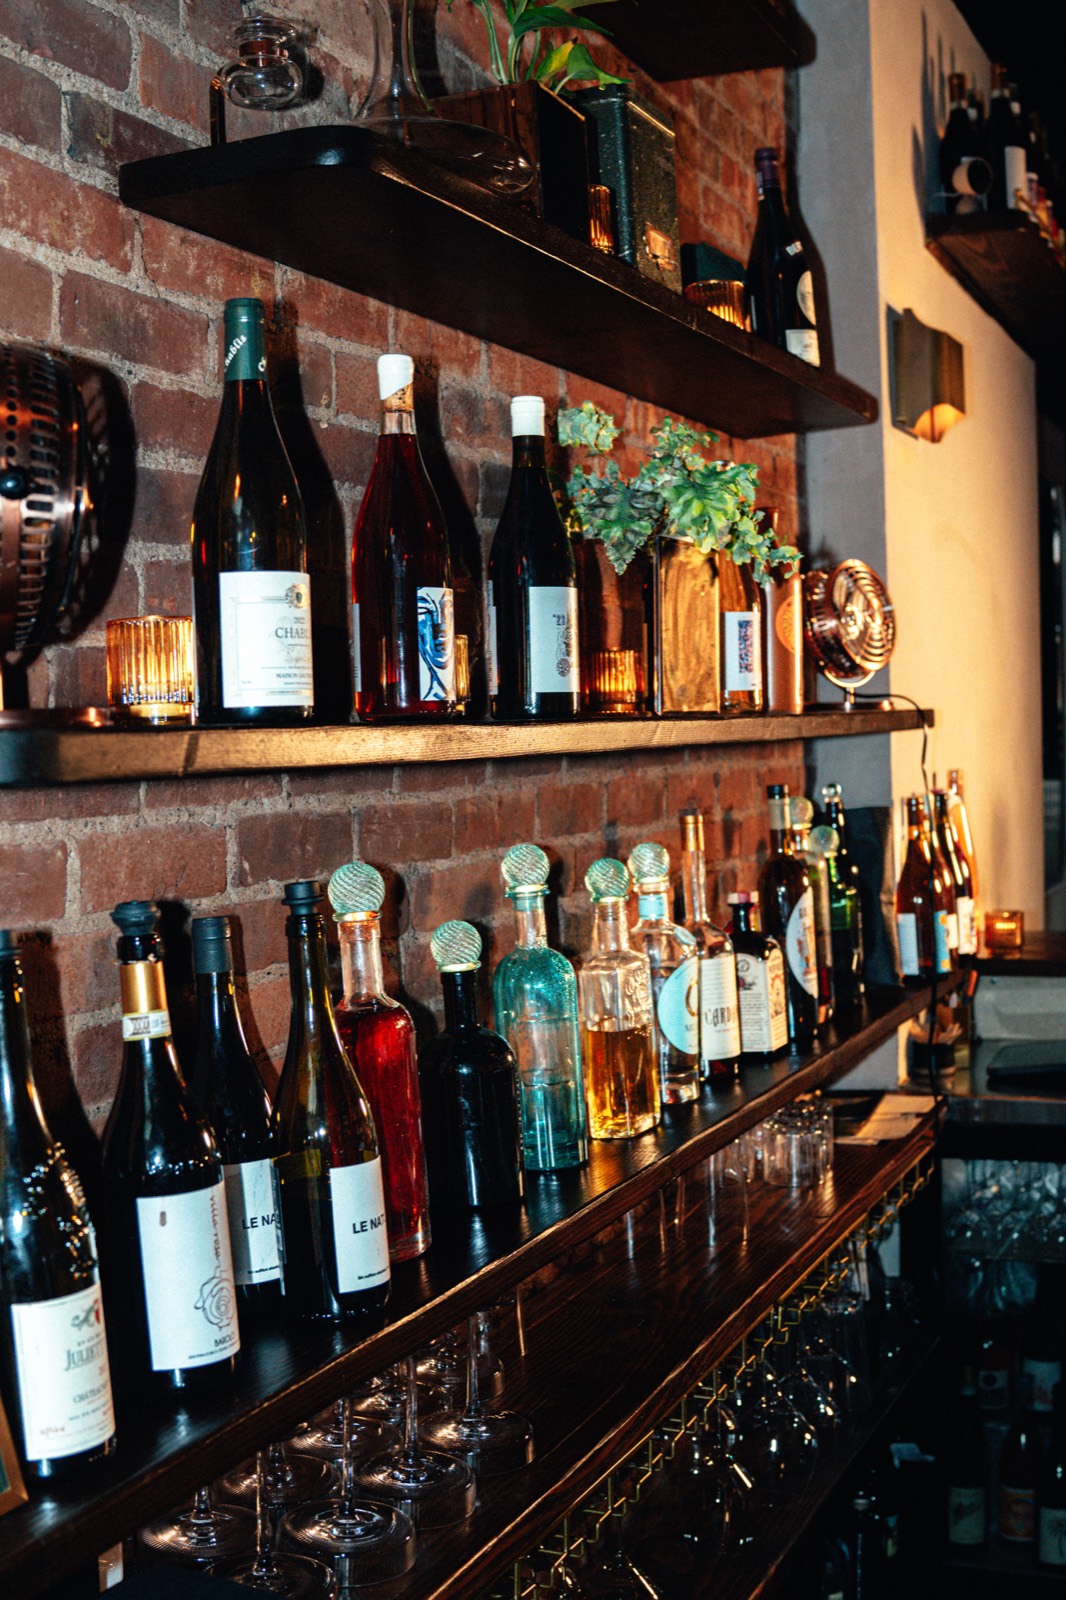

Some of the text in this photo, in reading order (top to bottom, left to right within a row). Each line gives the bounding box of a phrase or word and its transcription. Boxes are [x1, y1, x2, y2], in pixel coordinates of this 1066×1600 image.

[224, 334, 247, 372] hablis
[242, 1217, 259, 1230] LE
[352, 1220, 369, 1234] LE
